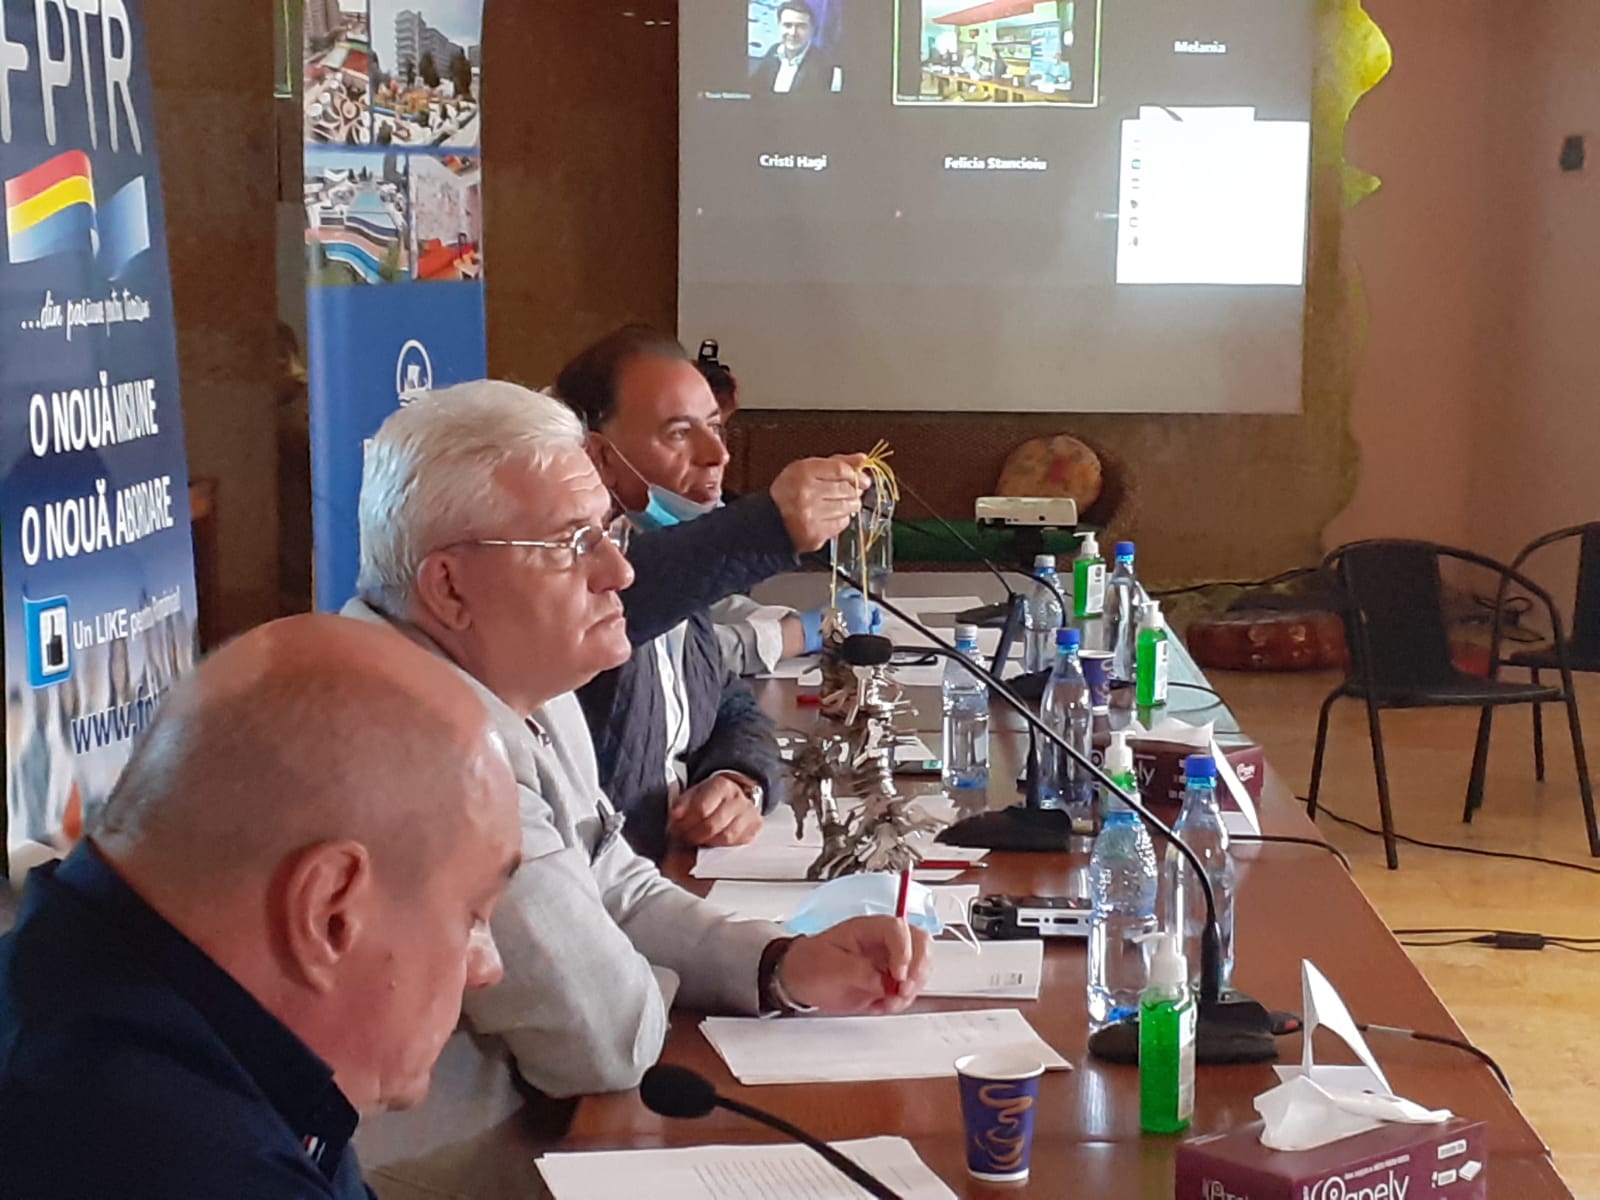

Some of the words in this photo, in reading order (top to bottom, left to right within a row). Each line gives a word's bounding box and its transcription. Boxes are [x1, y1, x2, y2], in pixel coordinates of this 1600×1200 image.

[1173, 39, 1226, 54] Melania
[759, 154, 794, 168] Cristi
[796, 155, 828, 171] Hagi
[944, 156, 985, 170] Felicia
[29, 393, 49, 457] O
[51, 370, 116, 454] NOUĂ
[21, 505, 42, 566] O
[45, 477, 113, 561] NOUĂ
[116, 475, 174, 546] ABORDARE
[72, 619, 94, 650] Un
[95, 607, 129, 645] LIKE
